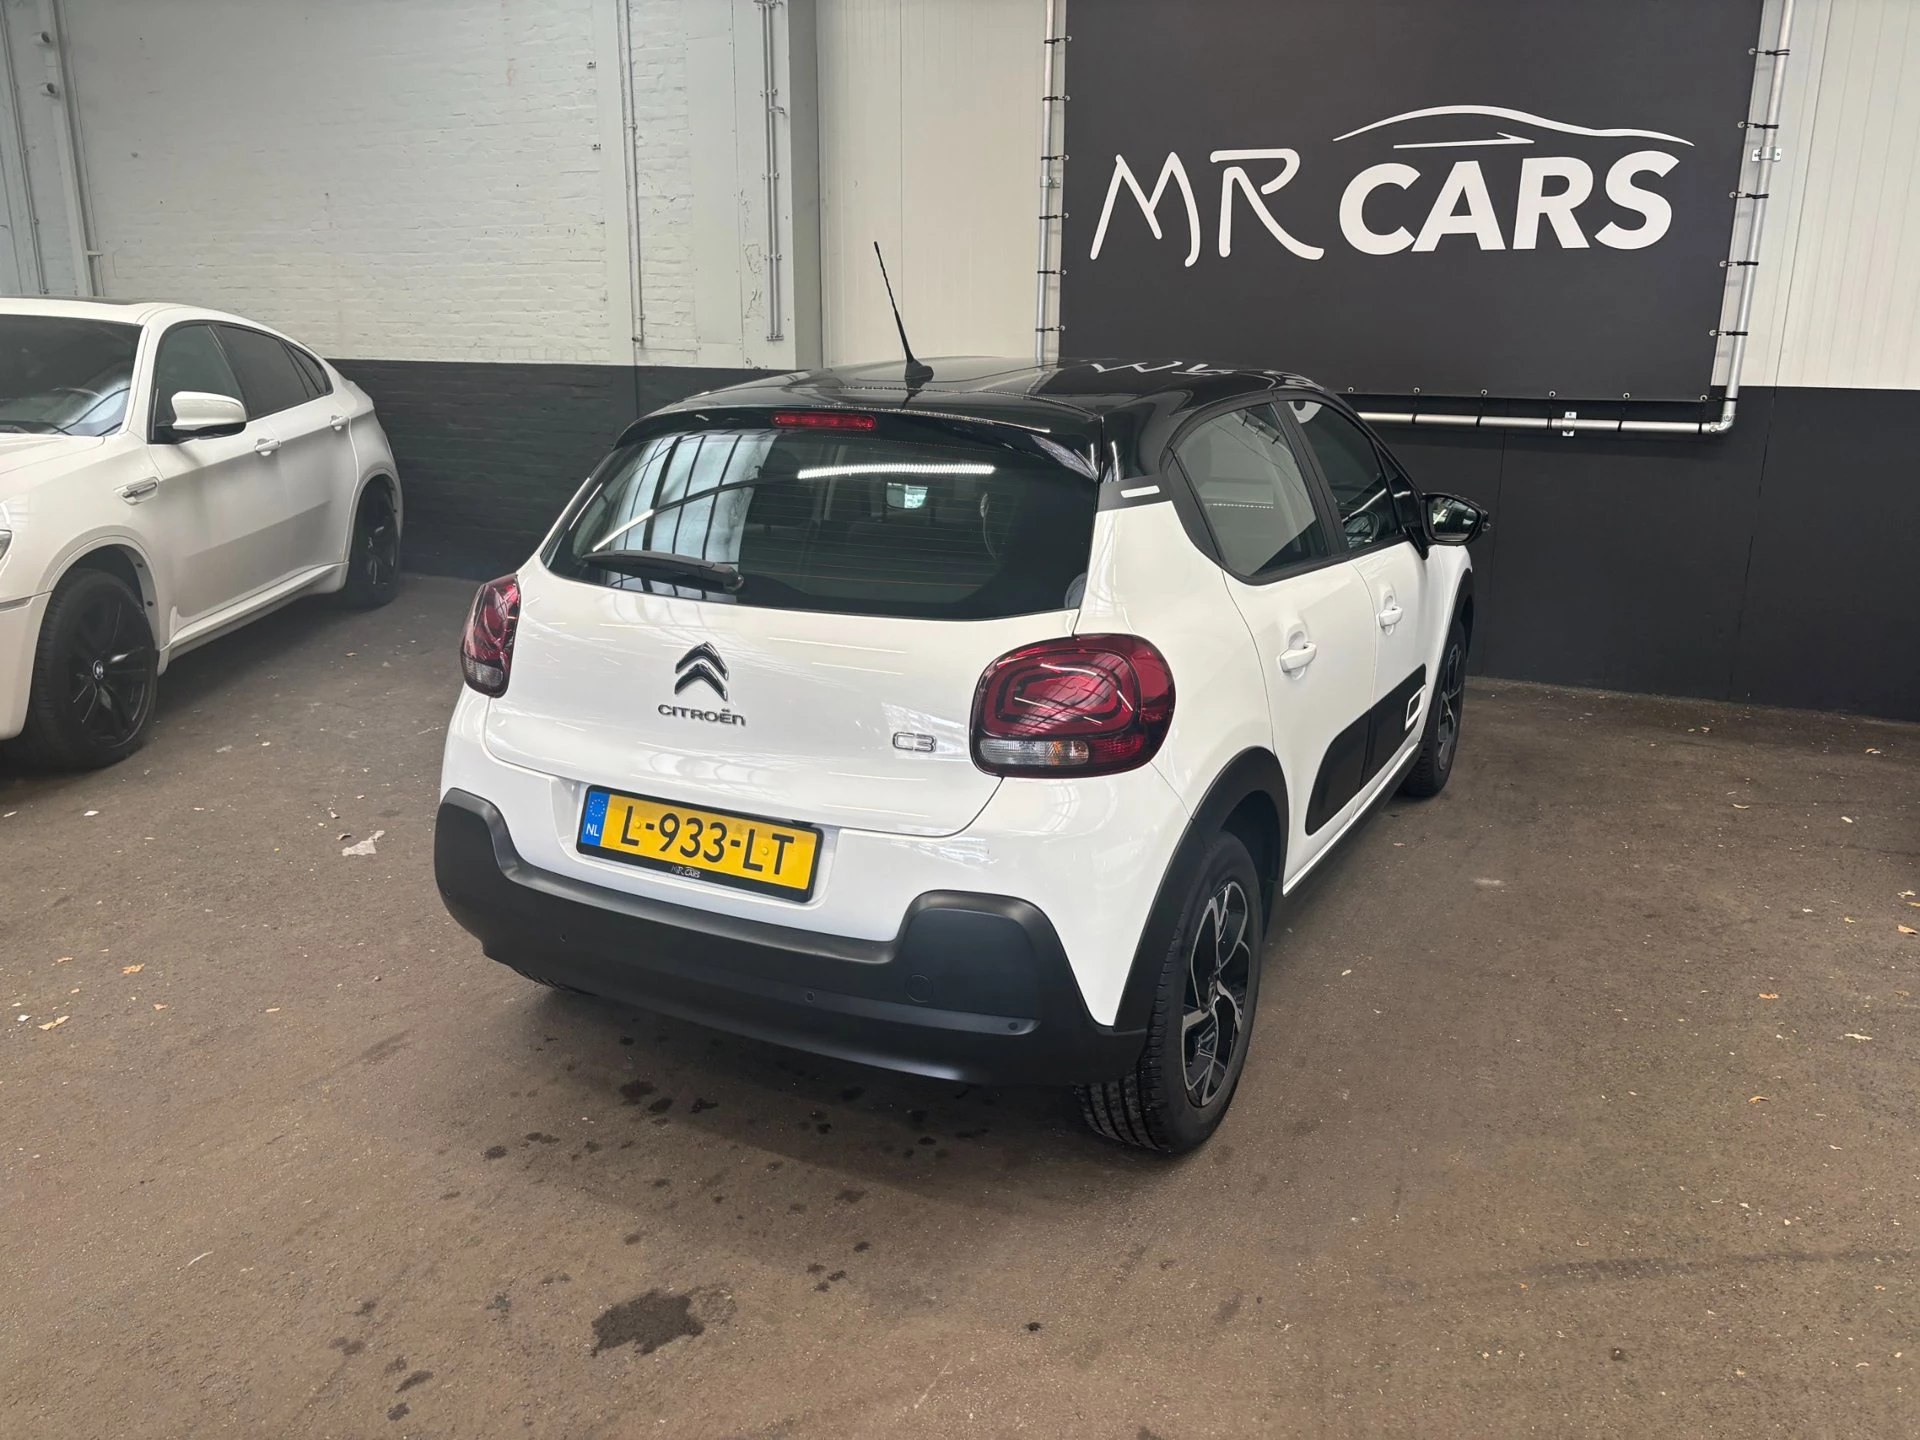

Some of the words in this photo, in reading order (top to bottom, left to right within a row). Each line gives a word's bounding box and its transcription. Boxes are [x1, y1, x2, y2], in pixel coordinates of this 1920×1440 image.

[1090, 148, 1324, 267] MR
[1338, 150, 1680, 256] CARS
[892, 731, 936, 752] C3
[585, 823, 600, 838] NL
[620, 805, 795, 875] L-933-LT
